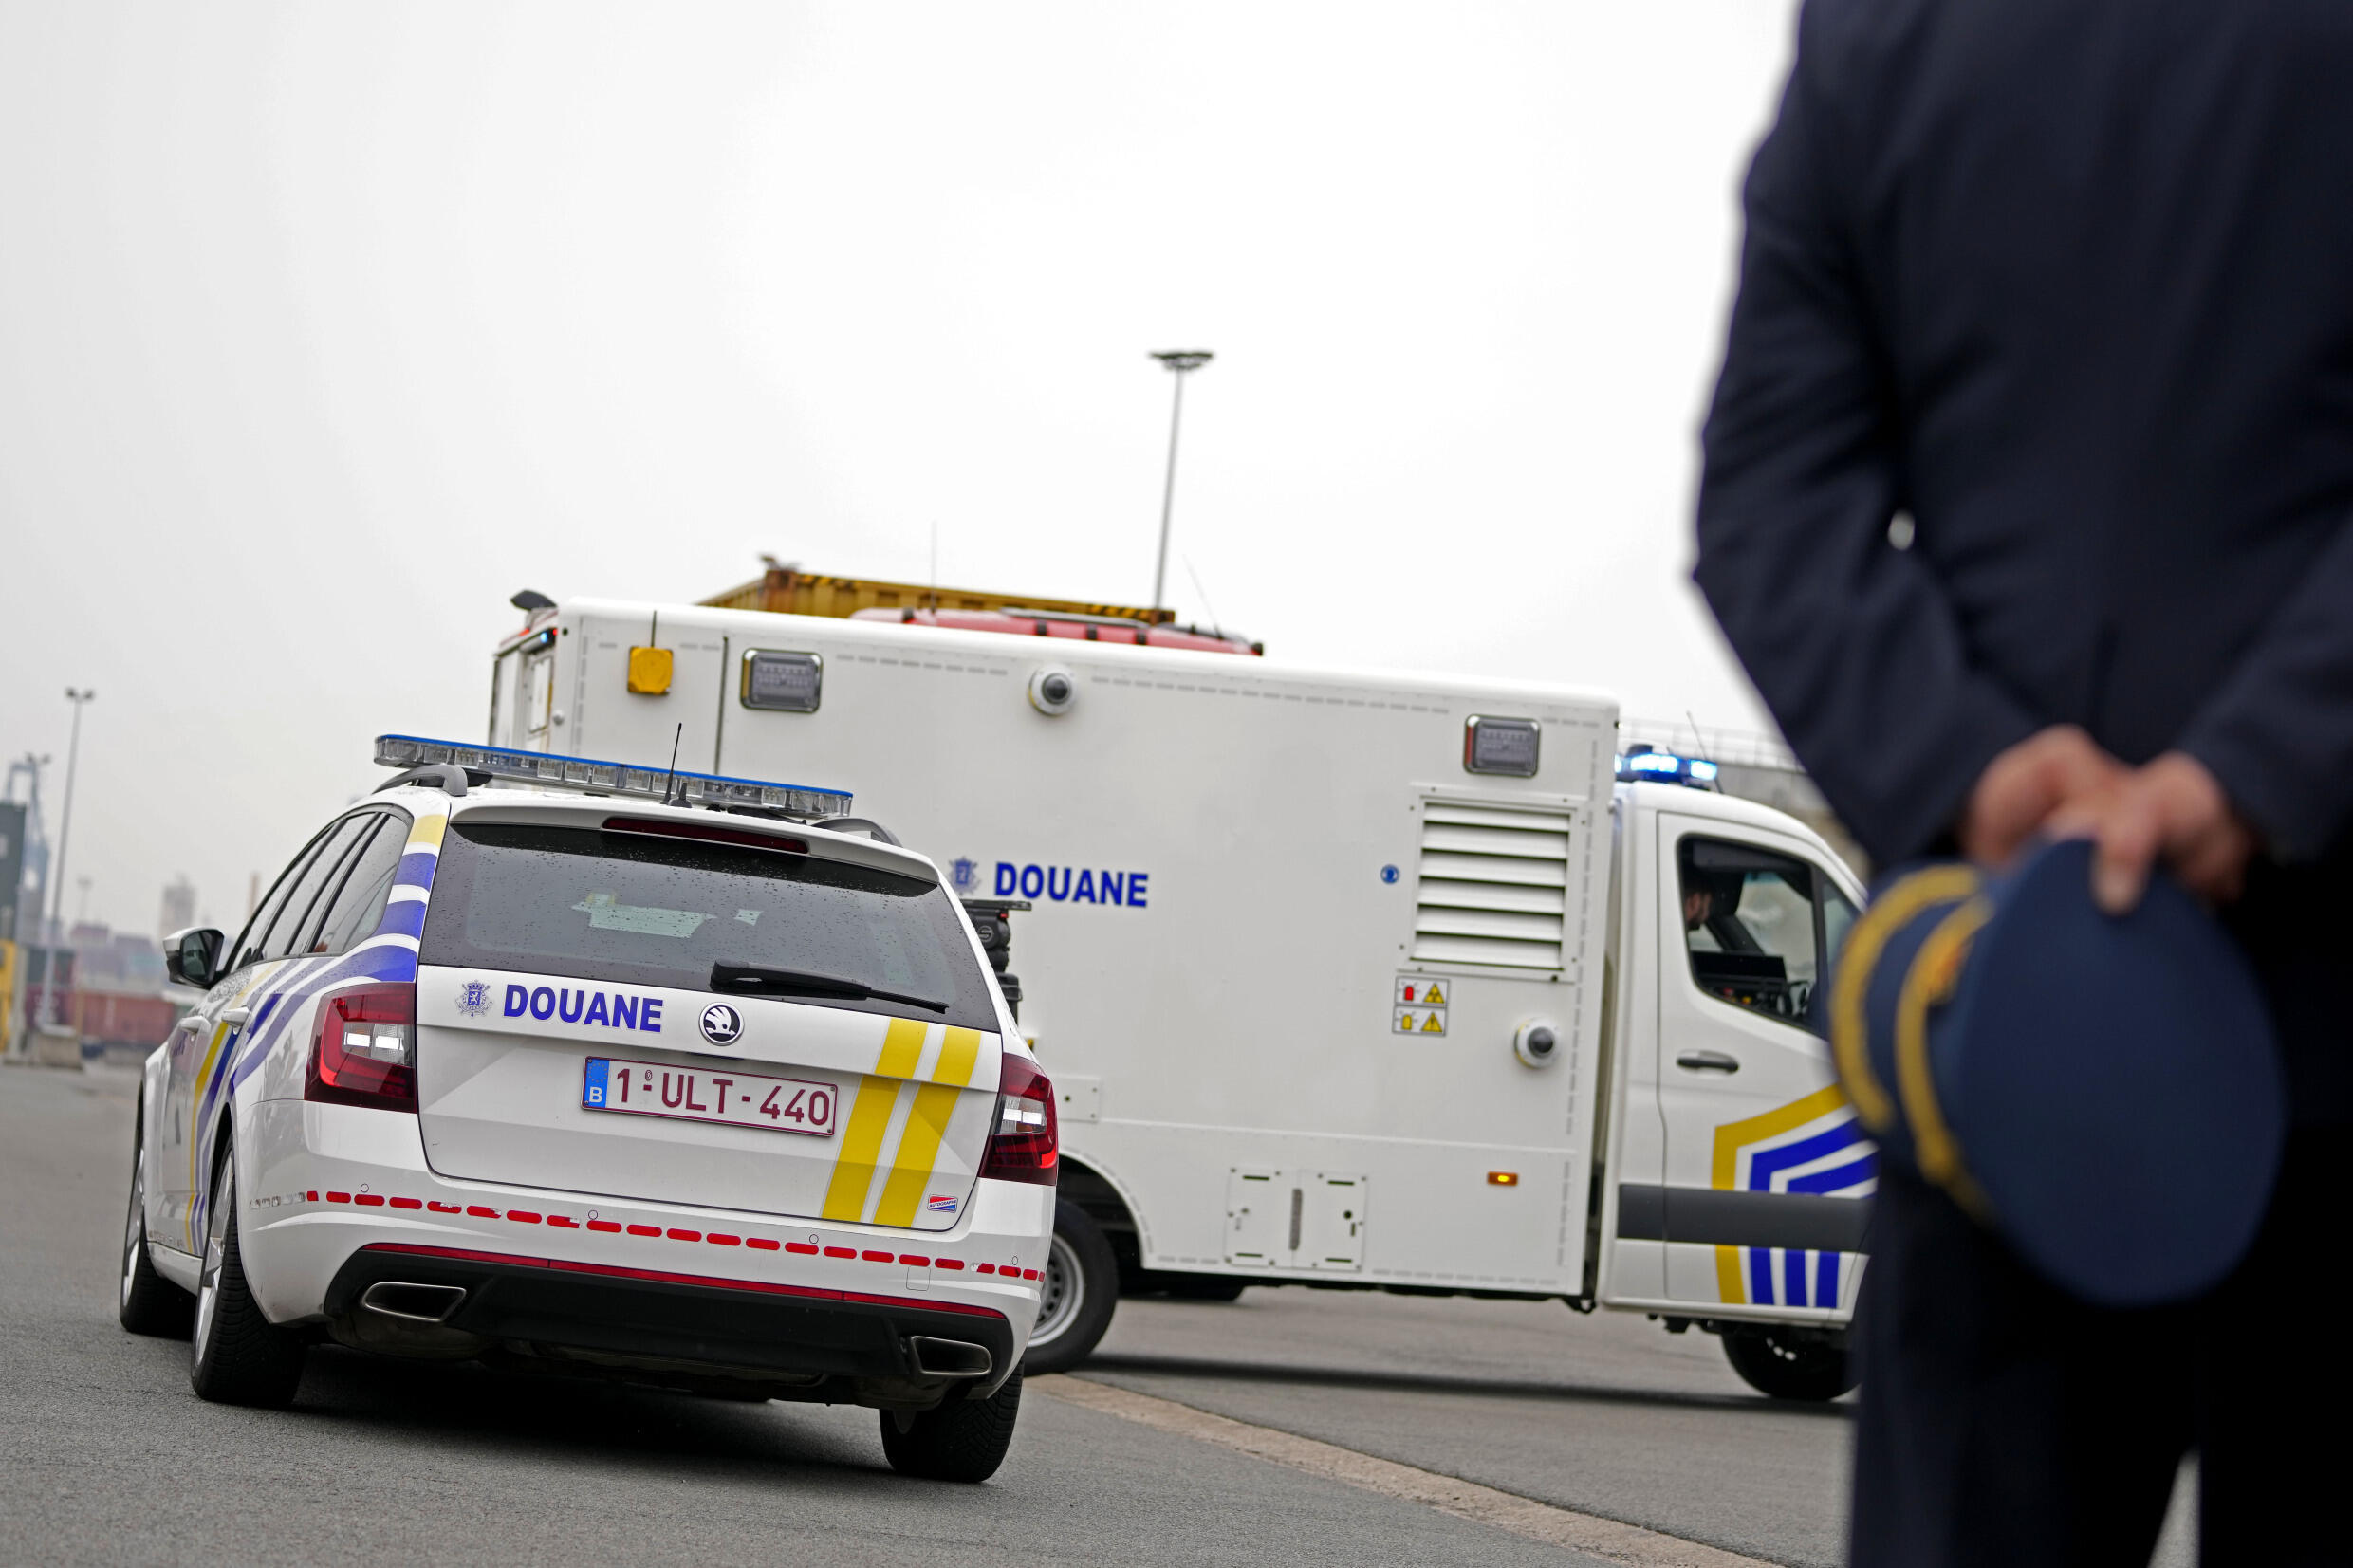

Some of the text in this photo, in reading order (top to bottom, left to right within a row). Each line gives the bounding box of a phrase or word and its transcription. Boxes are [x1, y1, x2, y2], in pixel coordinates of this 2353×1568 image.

[994, 861, 1148, 908] DOUANE
[503, 984, 663, 1033] DOUANE
[588, 1086, 603, 1103] B
[617, 1068, 829, 1126] 1-ULT-440
